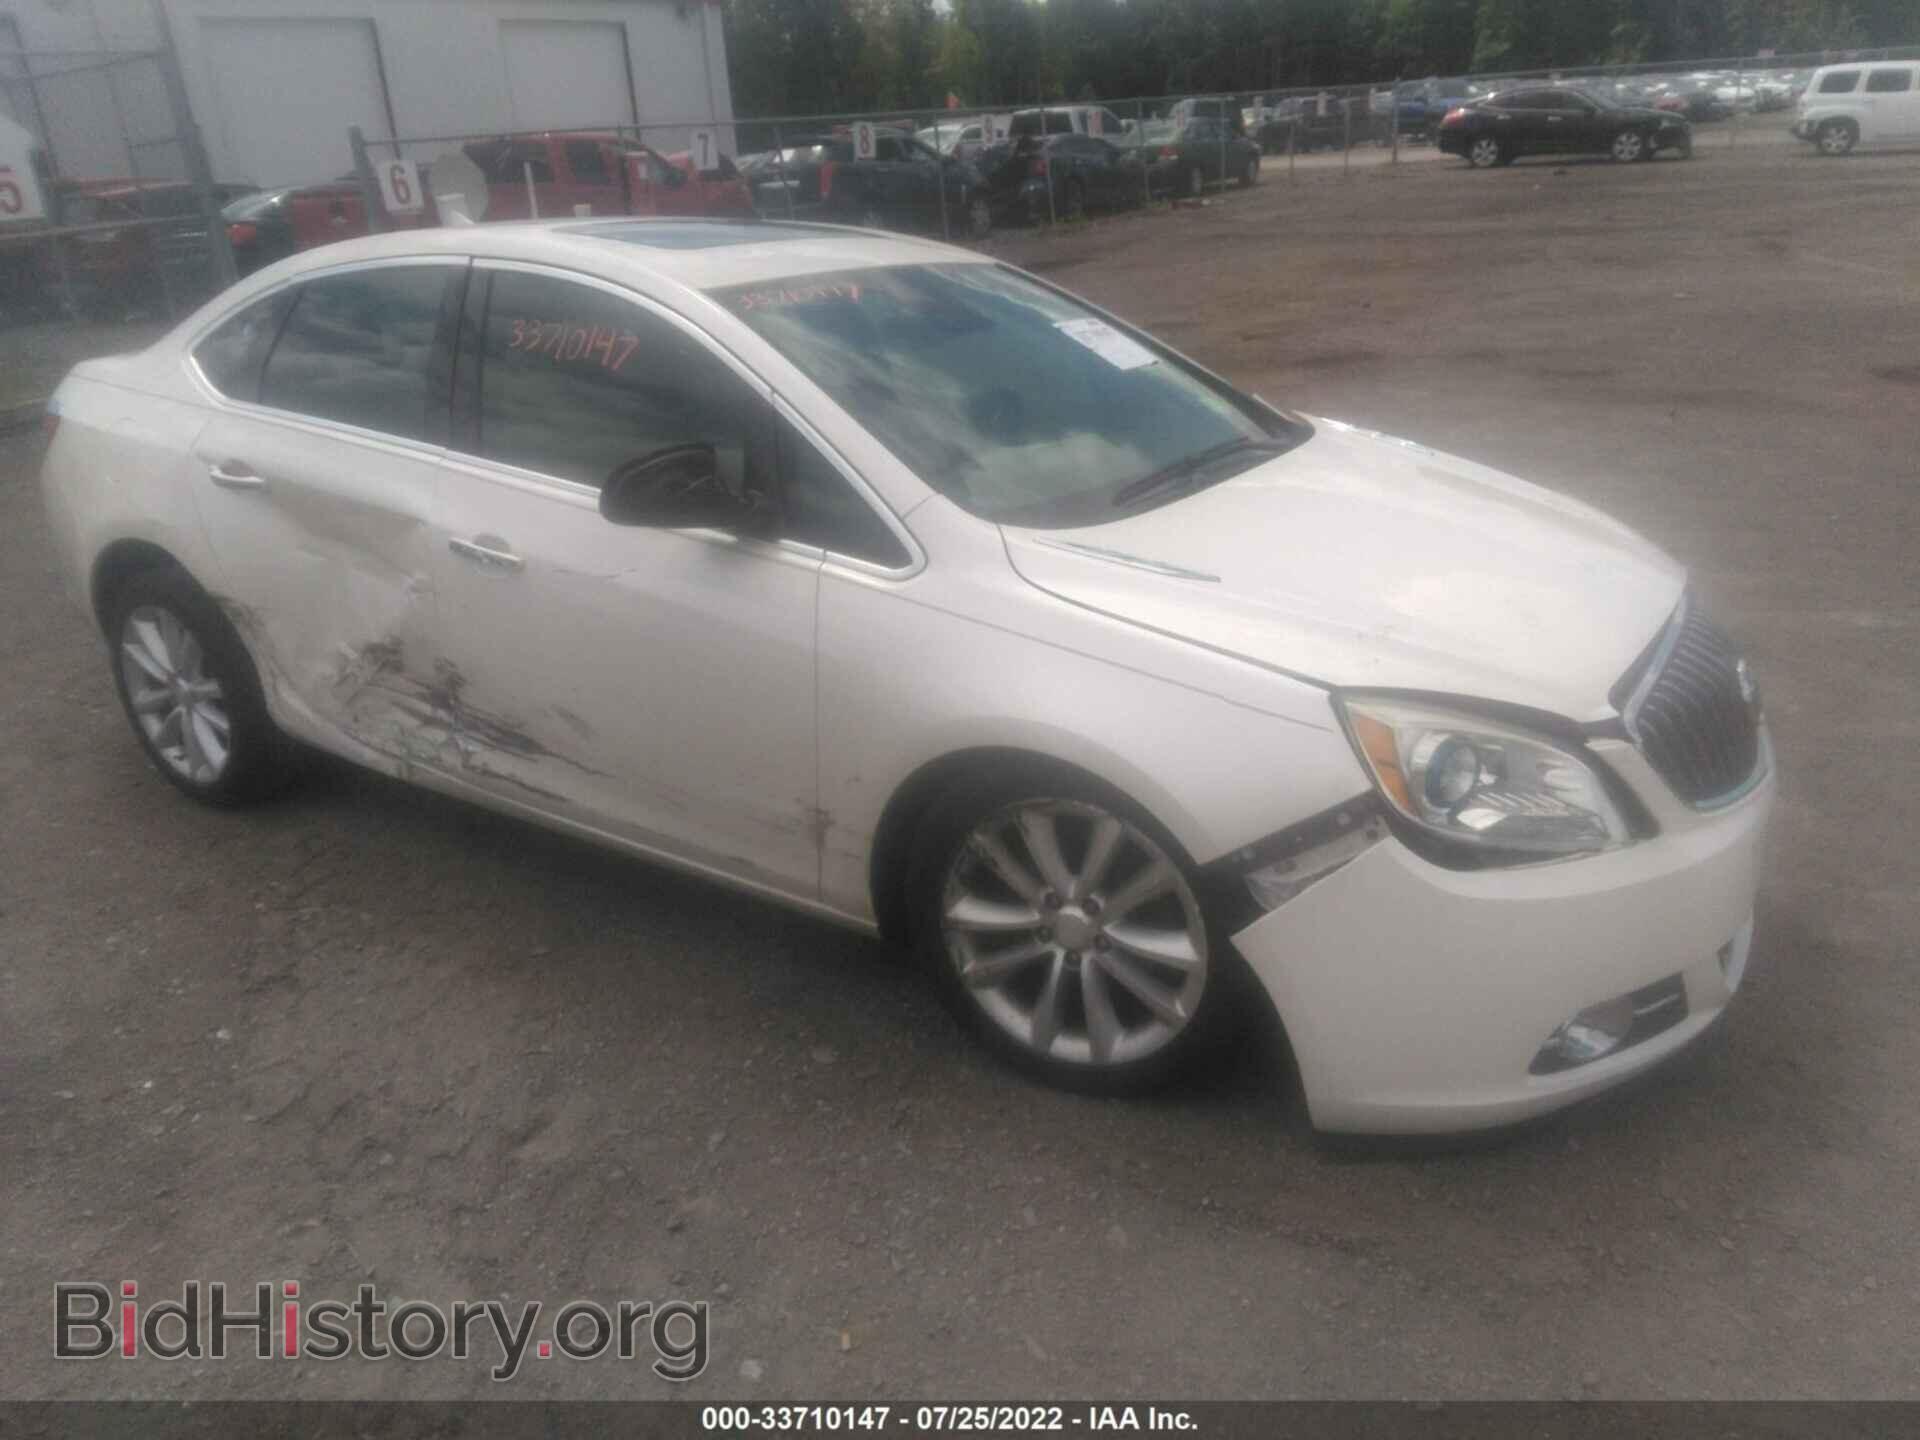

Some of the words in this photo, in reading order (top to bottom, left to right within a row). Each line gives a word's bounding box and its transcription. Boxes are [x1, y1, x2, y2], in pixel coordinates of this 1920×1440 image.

[859, 125, 871, 154] 8
[390, 164, 411, 205] 6
[509, 319, 640, 370] 33710147
